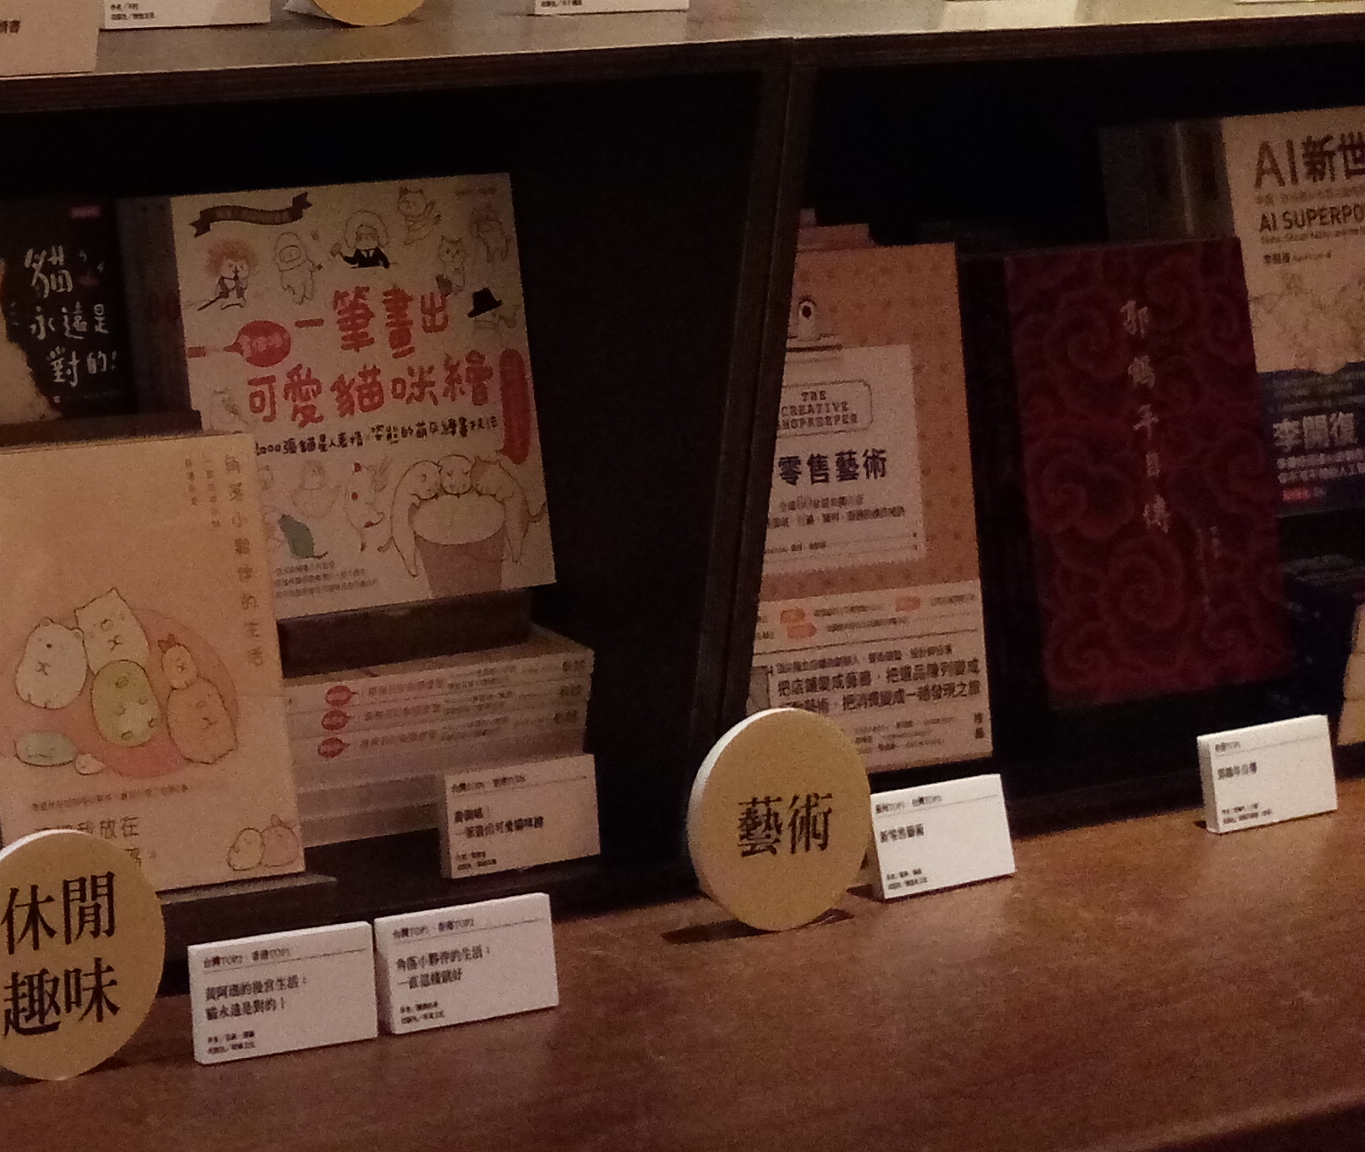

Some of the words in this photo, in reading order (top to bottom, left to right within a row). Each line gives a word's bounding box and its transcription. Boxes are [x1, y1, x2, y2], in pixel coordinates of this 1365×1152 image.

[25, 244, 73, 298] 貓
[30, 301, 109, 341] 永遠是
[295, 287, 450, 359] 一筆畫出
[248, 351, 494, 430] 可愛貓咪繪
[777, 447, 887, 486] 零售藝術
[737, 793, 833, 858] 藝術
[0, 872, 118, 955] 休閒
[3, 958, 122, 1038] 趣味
